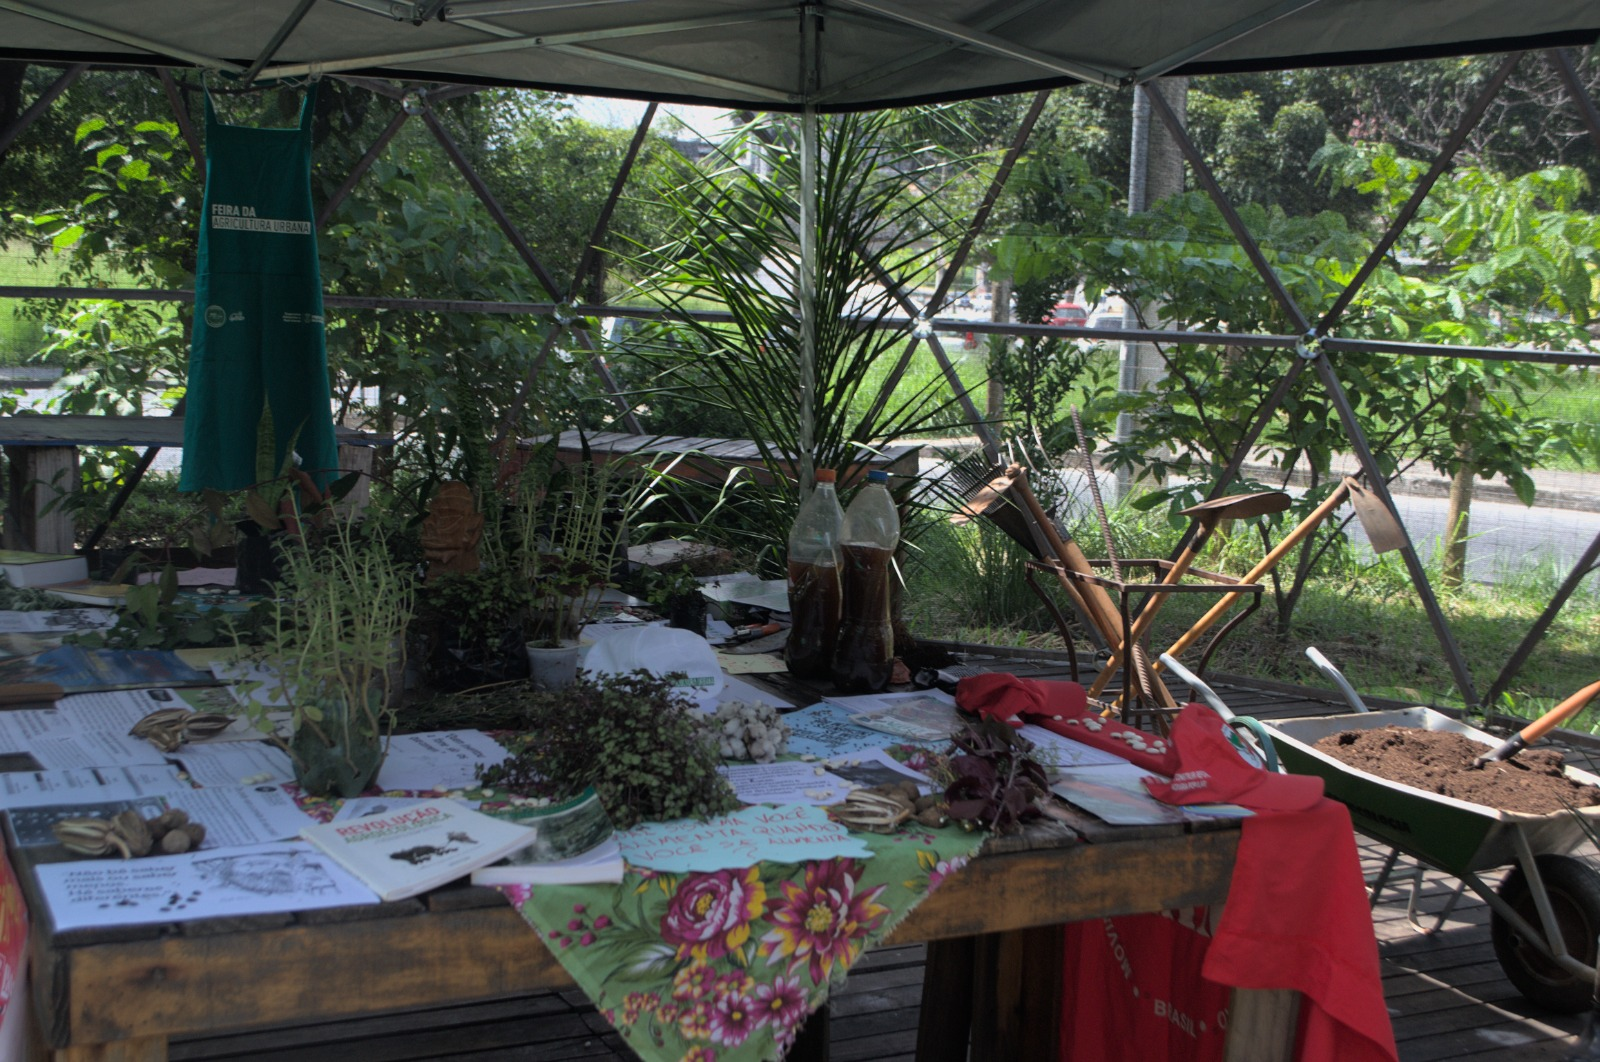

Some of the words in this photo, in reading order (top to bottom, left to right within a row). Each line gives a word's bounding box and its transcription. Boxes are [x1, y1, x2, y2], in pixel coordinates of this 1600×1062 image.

[212, 204, 240, 216] FEIRA
[242, 206, 257, 217] DA
[212, 216, 272, 231] AGRICULTURA
[273, 220, 309, 233] URBANA
[336, 806, 441, 837] REVOLUÇÃO
[755, 806, 812, 823] VOCÊ
[618, 828, 748, 852] ALIMENTA
[752, 822, 841, 836] QUANDO
[768, 833, 851, 845] ALIMENTA
